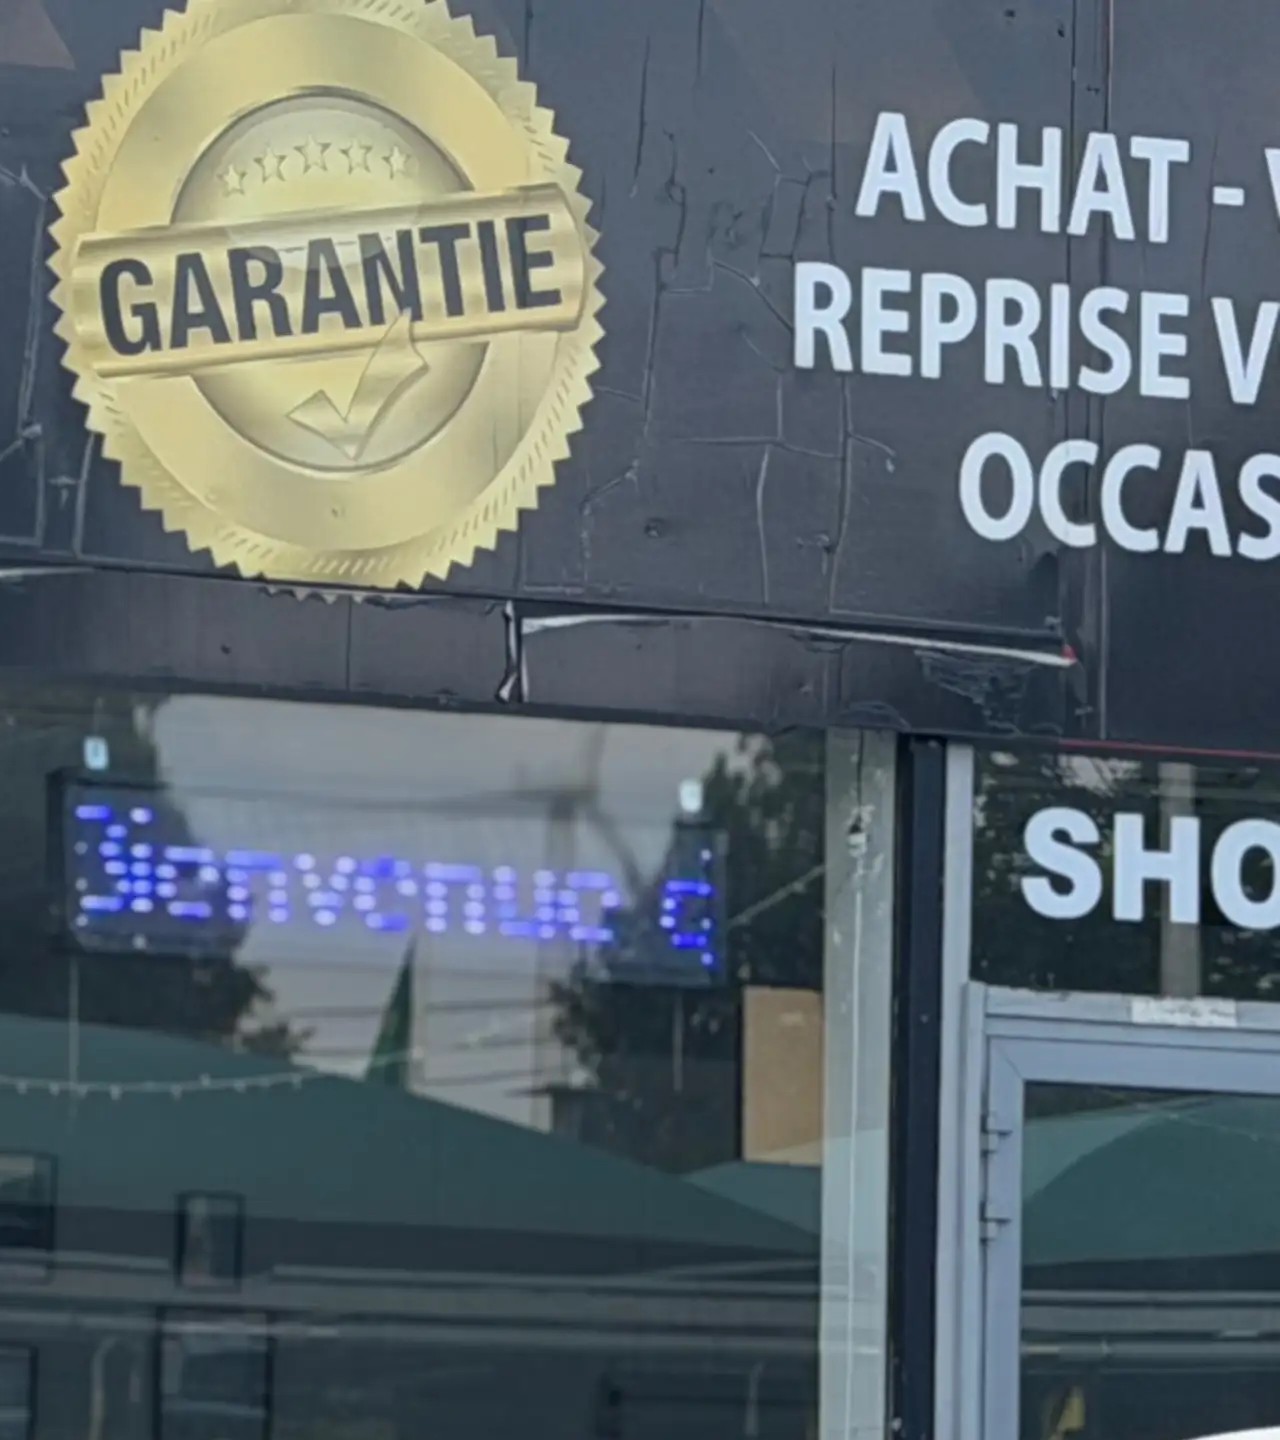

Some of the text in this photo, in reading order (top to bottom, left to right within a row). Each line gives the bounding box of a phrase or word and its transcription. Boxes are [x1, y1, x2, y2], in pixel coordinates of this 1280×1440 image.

[854, 111, 1190, 243] ACHAT
[99, 214, 563, 357] GARANTIE
[793, 261, 1190, 399] REPRISE
[1021, 806, 1280, 930] SHO
